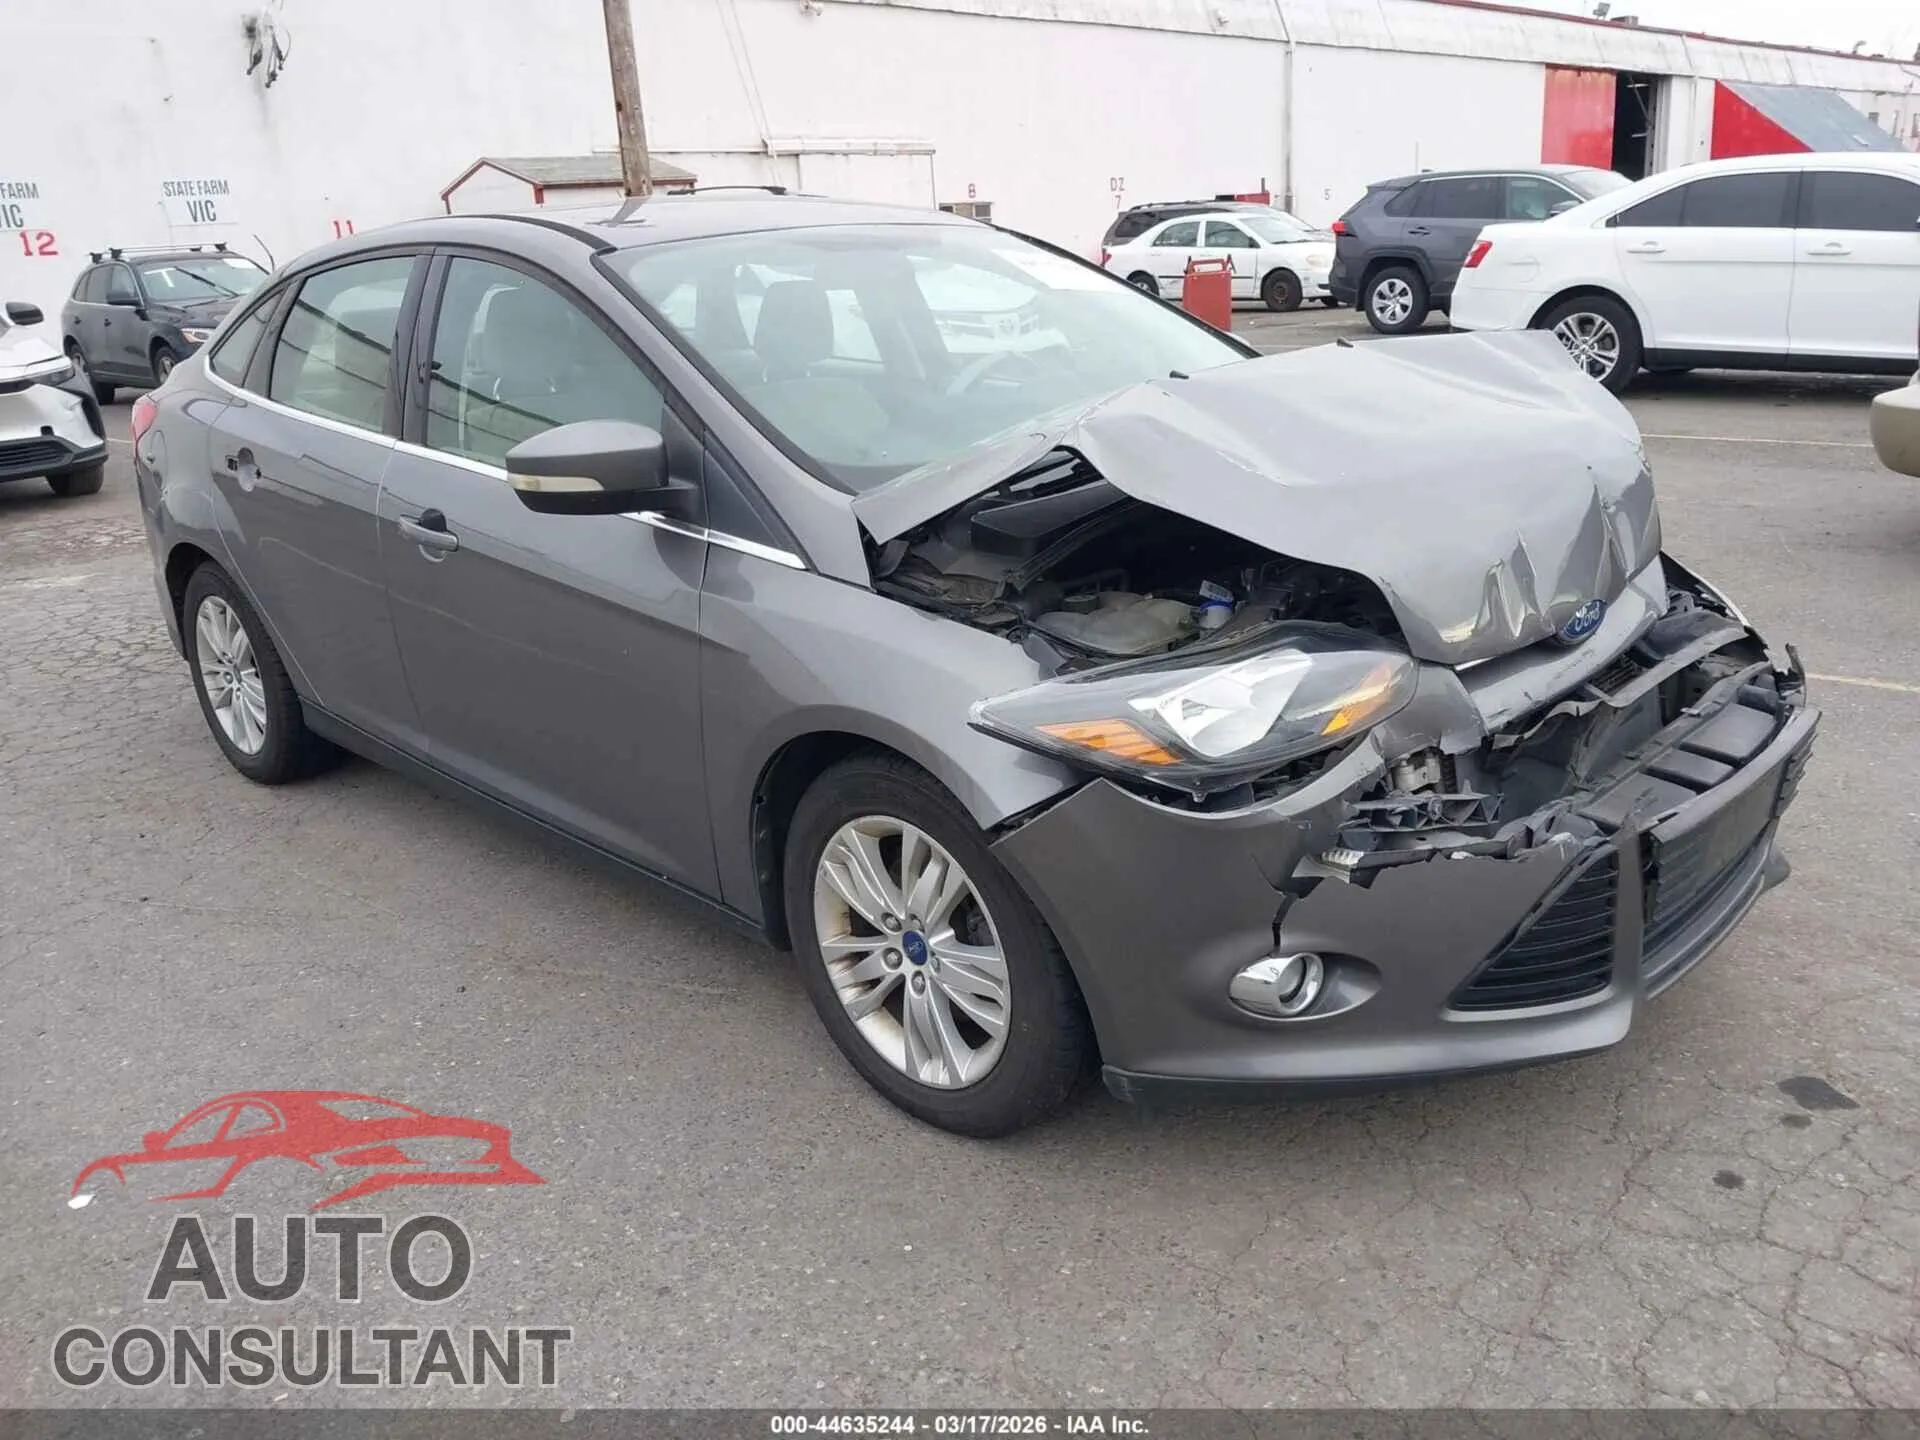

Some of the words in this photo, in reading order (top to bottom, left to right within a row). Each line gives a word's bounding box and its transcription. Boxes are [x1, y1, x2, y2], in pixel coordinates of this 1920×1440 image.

[0, 182, 39, 199] FARM
[163, 180, 196, 197] STATE
[197, 179, 230, 195] FARM
[0, 204, 24, 228] IC
[186, 199, 217, 223] VIC
[19, 231, 58, 256] 12
[1572, 601, 1600, 632] Ford
